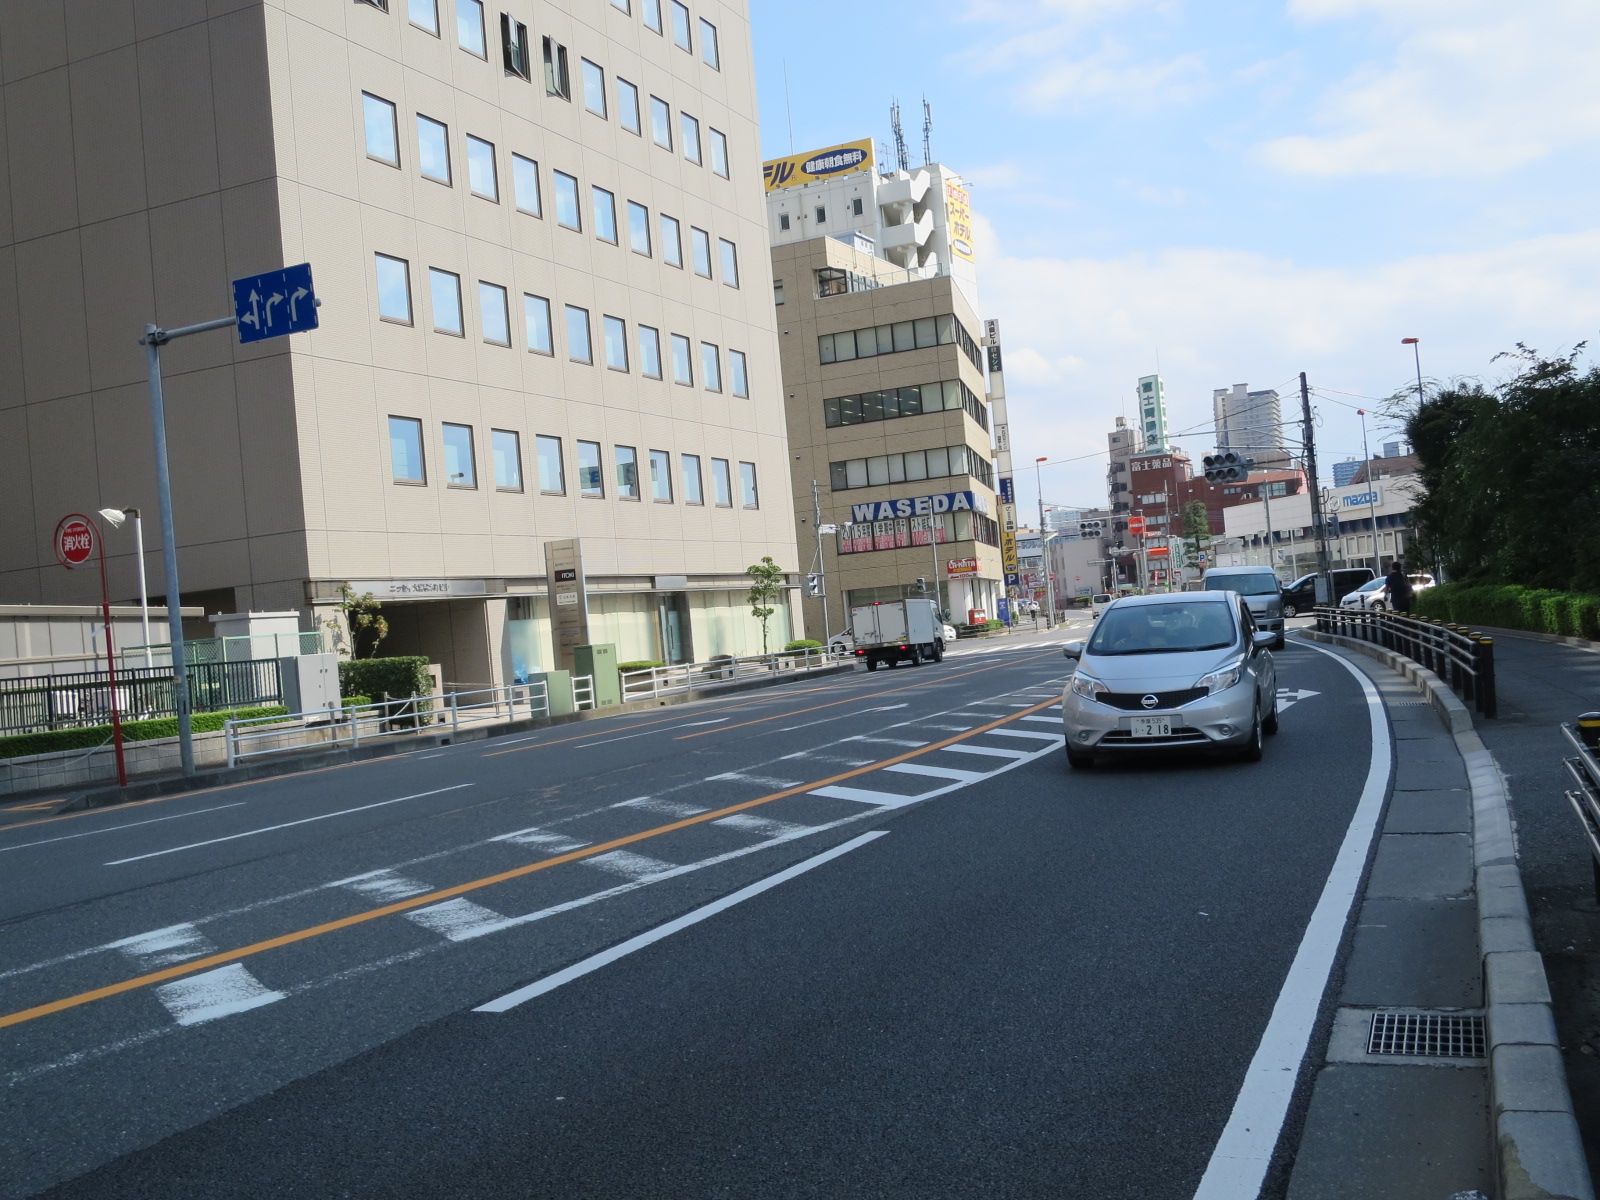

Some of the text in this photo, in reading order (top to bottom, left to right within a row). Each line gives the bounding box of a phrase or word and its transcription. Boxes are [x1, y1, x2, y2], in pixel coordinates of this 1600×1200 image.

[805, 150, 862, 173] 健康朝食無料
[953, 221, 971, 240] ホテル
[1131, 457, 1172, 472] 富士薬品
[853, 493, 970, 522] WASEDA
[1343, 491, 1378, 507] mazda
[64, 533, 90, 552] 消火栓
[1008, 574, 1016, 584] P
